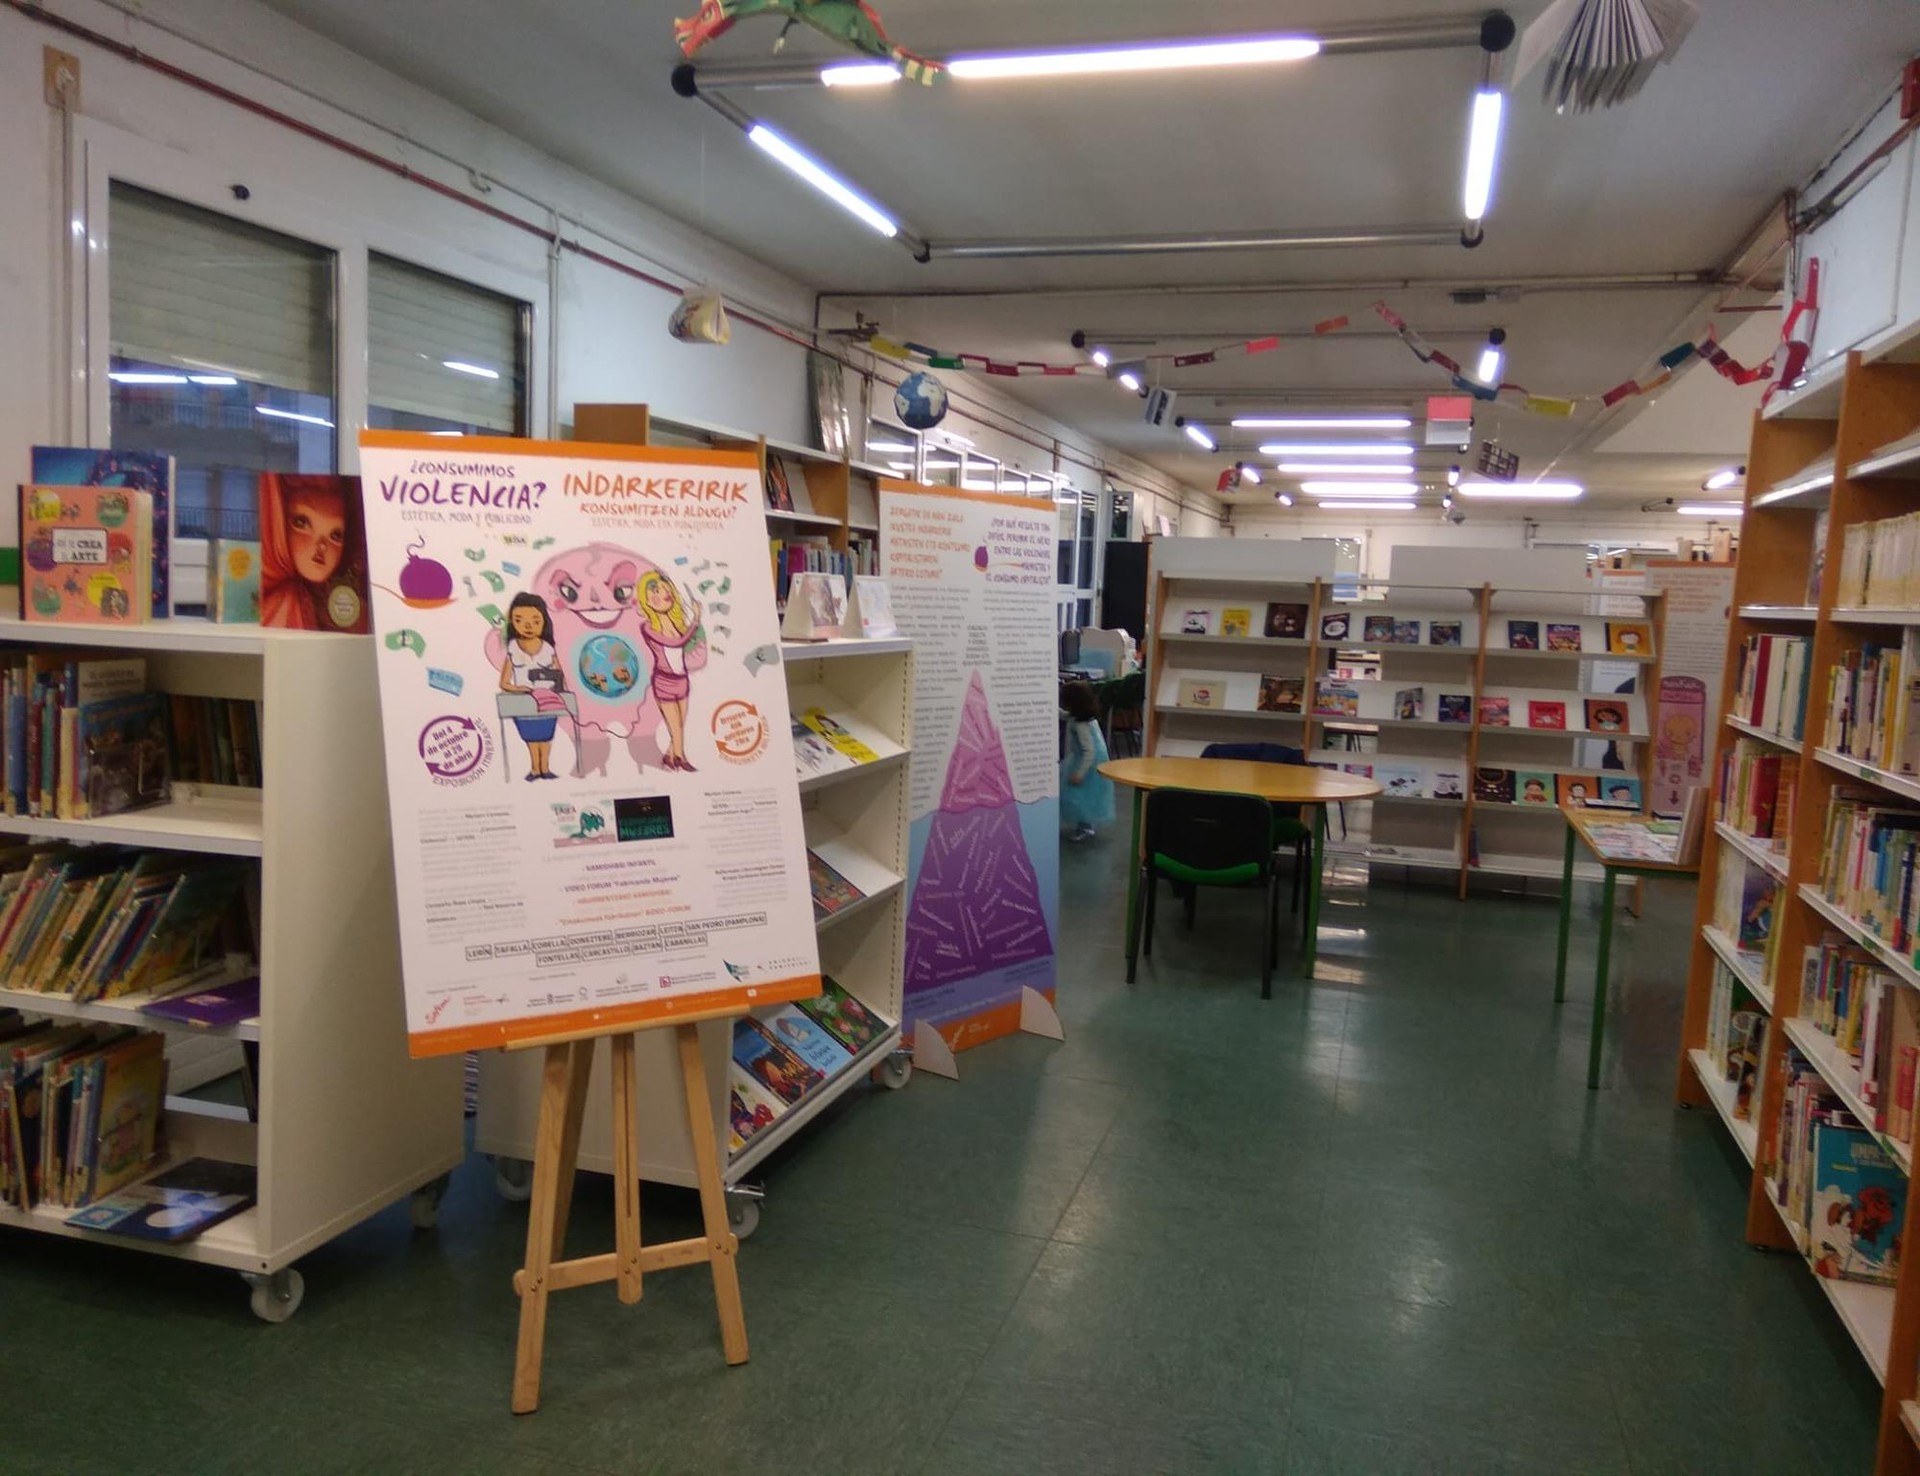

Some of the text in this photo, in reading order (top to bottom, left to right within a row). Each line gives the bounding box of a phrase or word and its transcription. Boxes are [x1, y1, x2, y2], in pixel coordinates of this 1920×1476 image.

[410, 460, 515, 478] ¿CONSUMIMOS
[379, 475, 547, 510] VIOLENCIA?
[563, 470, 749, 503] INDARKERIRIK
[580, 502, 679, 517] KONSUMITZEN
